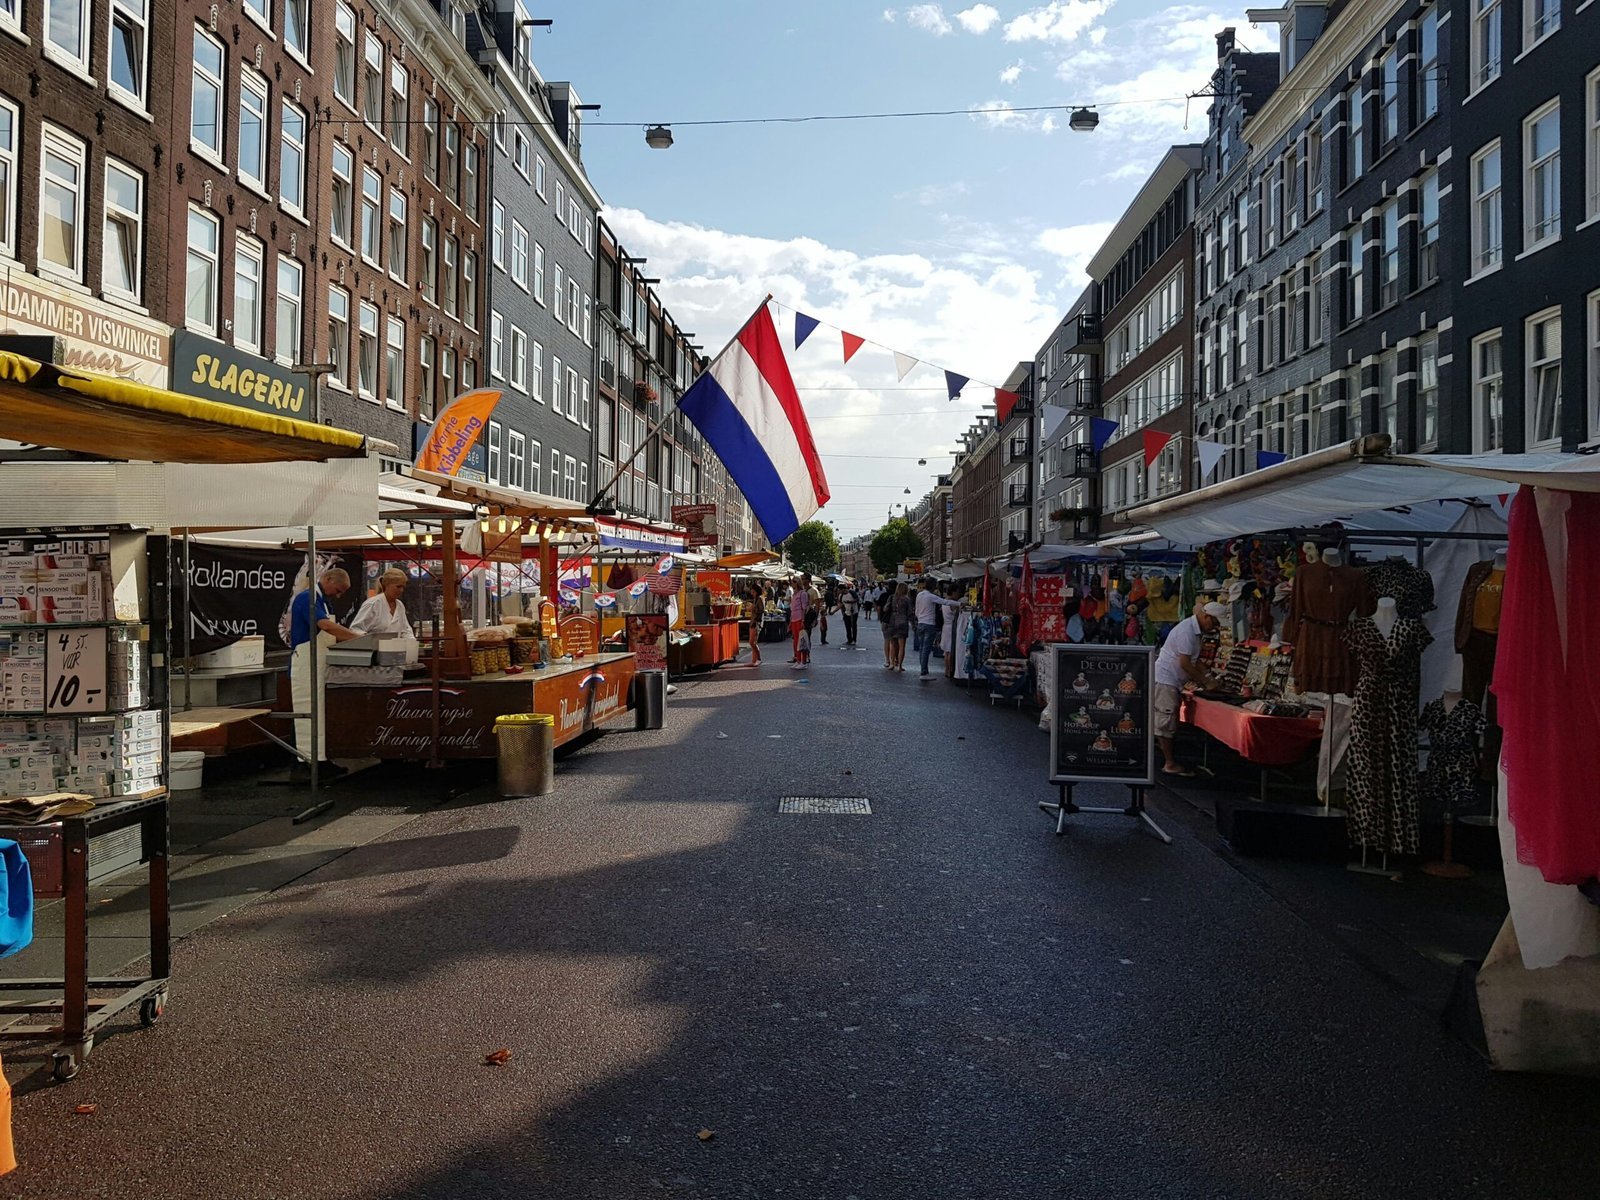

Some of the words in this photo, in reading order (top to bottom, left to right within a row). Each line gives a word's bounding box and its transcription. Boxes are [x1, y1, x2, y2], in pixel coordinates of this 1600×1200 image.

[88, 314, 162, 361] VISWINKEL
[65, 348, 143, 375] naar
[191, 353, 306, 413] SLAGERIJ
[430, 415, 459, 456] Warme
[436, 415, 482, 475] Kibbeling
[176, 556, 285, 590] Hollandse
[58, 633, 70, 652] 4
[1081, 660, 1095, 670] DE
[1097, 660, 1127, 671] CUYP
[370, 725, 486, 753] Haringandel
[1110, 726, 1141, 735] LUNCH
